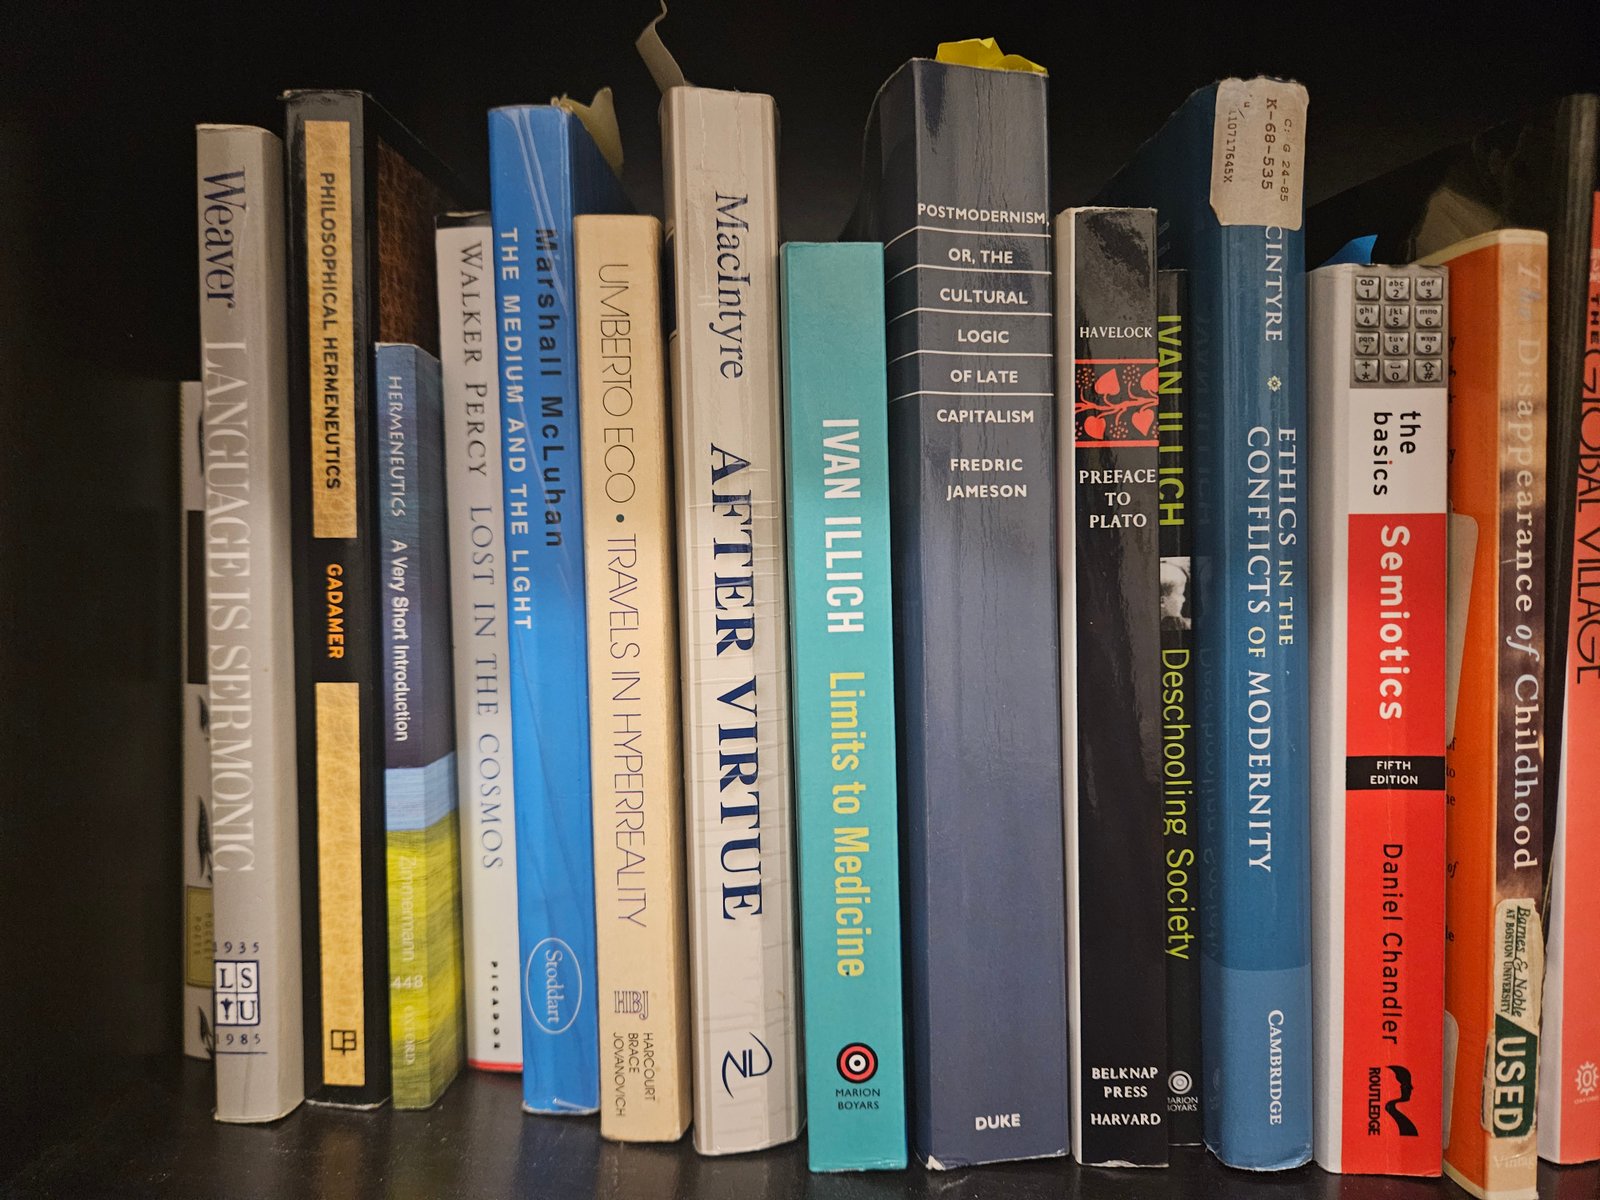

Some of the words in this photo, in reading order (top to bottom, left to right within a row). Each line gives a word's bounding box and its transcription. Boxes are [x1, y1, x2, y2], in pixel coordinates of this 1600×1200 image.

[1261, 98, 1278, 189] K-68-535
[1282, 144, 1292, 153] G
[1280, 161, 1291, 202] 24-85
[203, 165, 246, 309] Weaver
[917, 203, 1050, 226] POSTMODERNISM,
[320, 172, 339, 330] PHILOSOPHICAL
[500, 229, 519, 280] THE
[948, 248, 975, 264] OR,
[980, 250, 1013, 264] THE
[460, 240, 482, 366] WALKER
[535, 228, 561, 376] Marshall
[708, 193, 752, 380] MacIntyre
[939, 288, 1028, 305] CULTURAL
[1364, 290, 1370, 298] 1
[1393, 290, 1400, 298] 2
[1425, 290, 1433, 298] 3
[598, 263, 633, 416] UMBERTO
[957, 328, 1010, 344] LOGIC
[1079, 326, 1153, 339] HAVELOCK
[1392, 317, 1400, 326] 5
[1425, 317, 1433, 326] 6
[503, 294, 523, 403] MEDIUM
[1158, 315, 1183, 395] IVAN
[1363, 345, 1369, 353] 7
[1392, 345, 1400, 353] 8
[1425, 345, 1432, 353] 9
[950, 370, 974, 384] OF
[976, 370, 1018, 384] LATE
[1392, 372, 1400, 380] 0
[324, 338, 341, 490] HERMENEUTICS
[465, 383, 488, 477] PERCY
[936, 410, 1034, 424] CAPITALISM
[1399, 410, 1421, 454] the
[203, 341, 252, 577] LANGUAGE
[388, 375, 406, 517] HERMENEUTICS
[507, 419, 526, 473] AND
[603, 427, 636, 504] ECO
[821, 418, 861, 499] IVAN
[950, 459, 1023, 472] FREDRIC
[1373, 411, 1393, 496] basics
[541, 395, 566, 548] McLuhan
[947, 485, 1027, 501] JAMESON
[1079, 468, 1156, 484] PREFACE
[1278, 427, 1297, 547] ETHICS
[1508, 340, 1540, 611] Disappearance
[510, 484, 529, 534] THE
[1089, 513, 1147, 528] PLATO
[1105, 492, 1131, 506] TO
[1247, 427, 1270, 613] CONFLICTS
[390, 539, 408, 554] A
[471, 505, 495, 586] LOST
[711, 442, 756, 657] AFTER
[389, 557, 409, 592] Very
[512, 550, 531, 630] LIGHT
[606, 533, 641, 658] TRAVELS
[825, 516, 864, 633] ILLICH
[1279, 560, 1295, 586] IN
[208, 588, 251, 631] IS
[327, 563, 345, 660] GADAMER
[391, 597, 409, 640] Short
[474, 603, 495, 637] IN
[1279, 599, 1293, 646] THE
[1379, 524, 1411, 720] Semiotics
[1248, 627, 1267, 658] OF
[1506, 624, 1538, 661] of
[391, 644, 410, 742] Introduction
[476, 652, 498, 715] THE
[612, 670, 640, 701] IN
[829, 671, 866, 771] Limits
[1161, 648, 1191, 836] Deschooling
[211, 645, 255, 871] SERMONIC
[1248, 670, 1271, 873] MODERNITY
[1369, 775, 1418, 785] EDITION
[1376, 760, 1411, 771] FIFTH
[1514, 675, 1539, 869] Childhood
[479, 733, 502, 870] COSMOS
[612, 713, 647, 928] HYPERREALITY
[717, 675, 763, 920] VIRTUE
[834, 783, 866, 814] to
[833, 826, 872, 977] Medicine
[1165, 848, 1195, 960] Society
[1382, 843, 1403, 921] Daniel
[400, 856, 416, 961] Zimmermann
[1506, 909, 1515, 919] AT
[1516, 906, 1531, 953] Barnes
[1504, 922, 1514, 957] BOSTON
[1513, 957, 1528, 971] &
[392, 976, 423, 988] 448
[491, 961, 500, 1049] PICADOR
[545, 950, 562, 1025] Stoddart
[1382, 931, 1403, 1044] Chandler
[1501, 961, 1512, 1013] UNIVERSITY
[1512, 977, 1527, 1018] Noble
[215, 1033, 260, 1045] 1985
[628, 1033, 639, 1073] BRACE
[614, 1032, 626, 1117] JOVANOVICH
[643, 1032, 657, 1101] HARCOURT
[1092, 1067, 1159, 1079] BELKNAP
[1268, 1009, 1283, 1126] CAMBRIDGE
[1494, 1036, 1526, 1132] USED
[835, 1088, 881, 1098] MARION
[837, 1100, 879, 1111] BOYARS
[1104, 1086, 1148, 1098] PRESS
[1368, 1066, 1380, 1136] ROUTLEDGE
[975, 1113, 1021, 1130] DUKE
[1090, 1113, 1161, 1125] HARVARD
